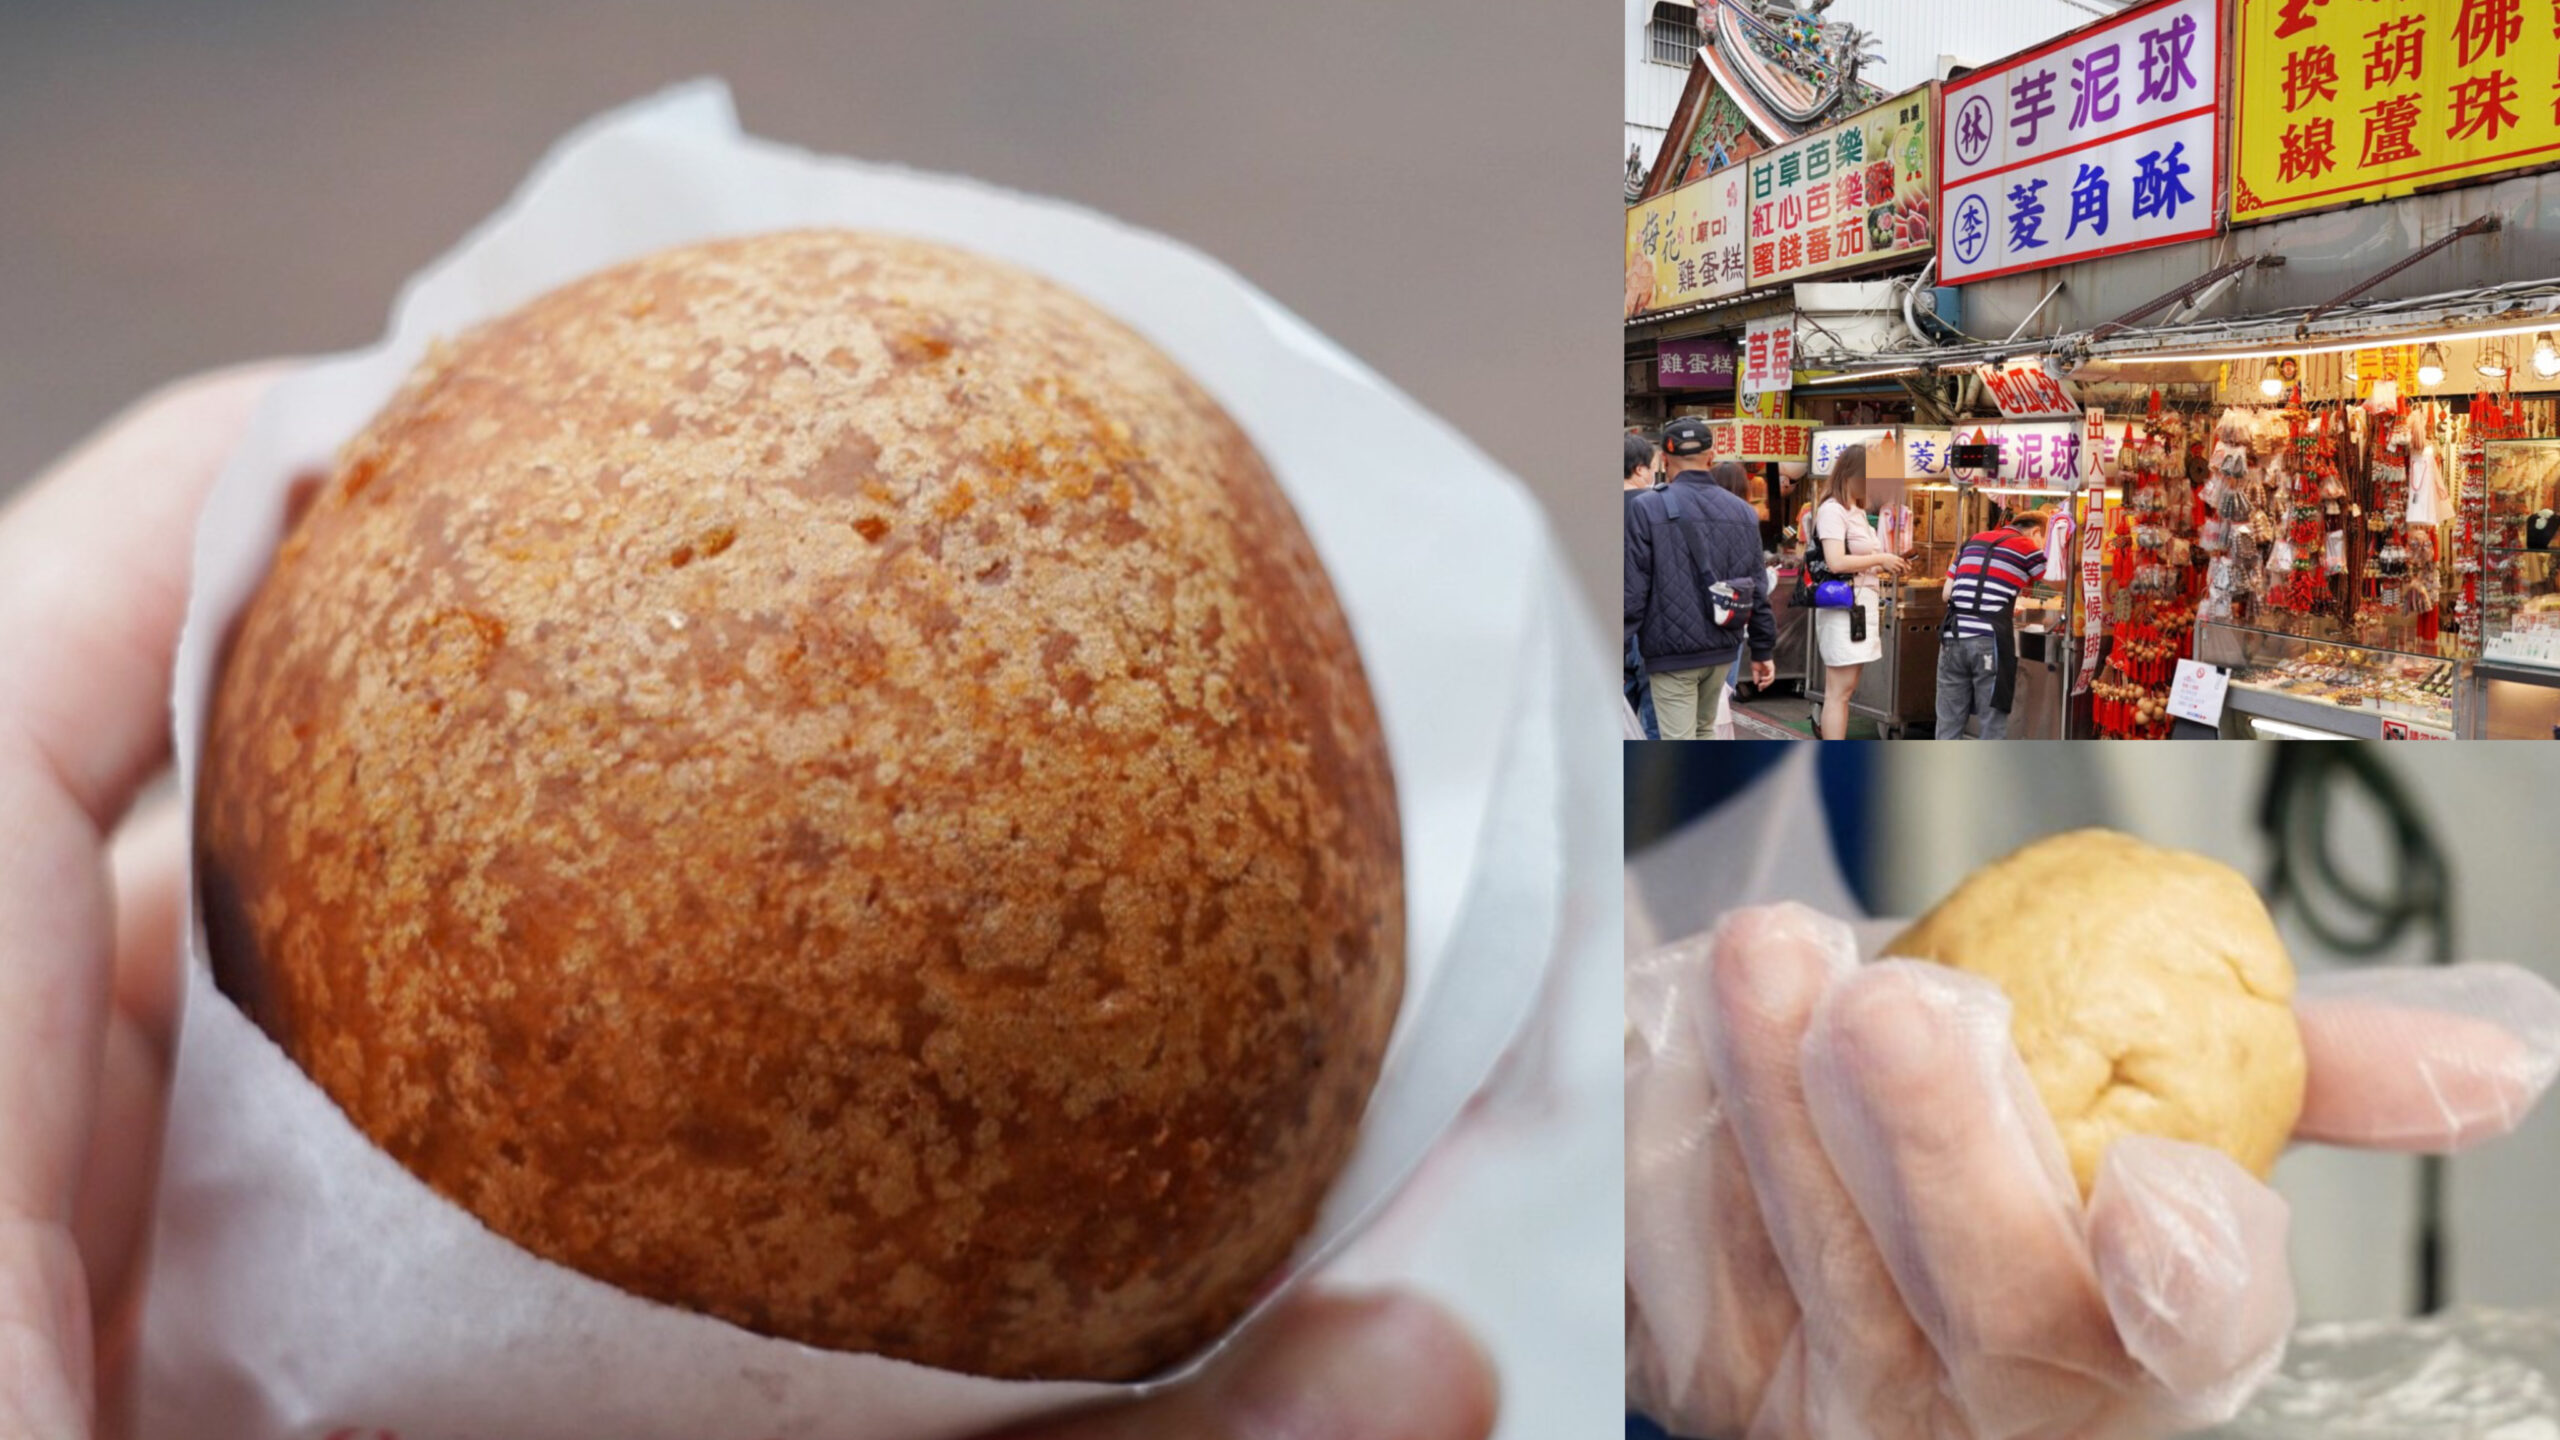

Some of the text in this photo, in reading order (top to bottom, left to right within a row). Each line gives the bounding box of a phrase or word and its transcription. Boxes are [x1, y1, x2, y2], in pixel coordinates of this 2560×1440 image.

[1959, 14, 2198, 157] 林 芋泥球
[1753, 126, 1863, 199] 甘草芭樂
[1752, 171, 1864, 238] 紅心芭樂
[2007, 141, 2196, 253] 菱角酥
[1678, 243, 1744, 294] 雞蛋糕
[1661, 352, 1733, 375] 雞蛋糕
[1747, 327, 1791, 389] 草莓
[1981, 367, 2075, 414] 地瓜球
[1713, 426, 1736, 455] 芭樂
